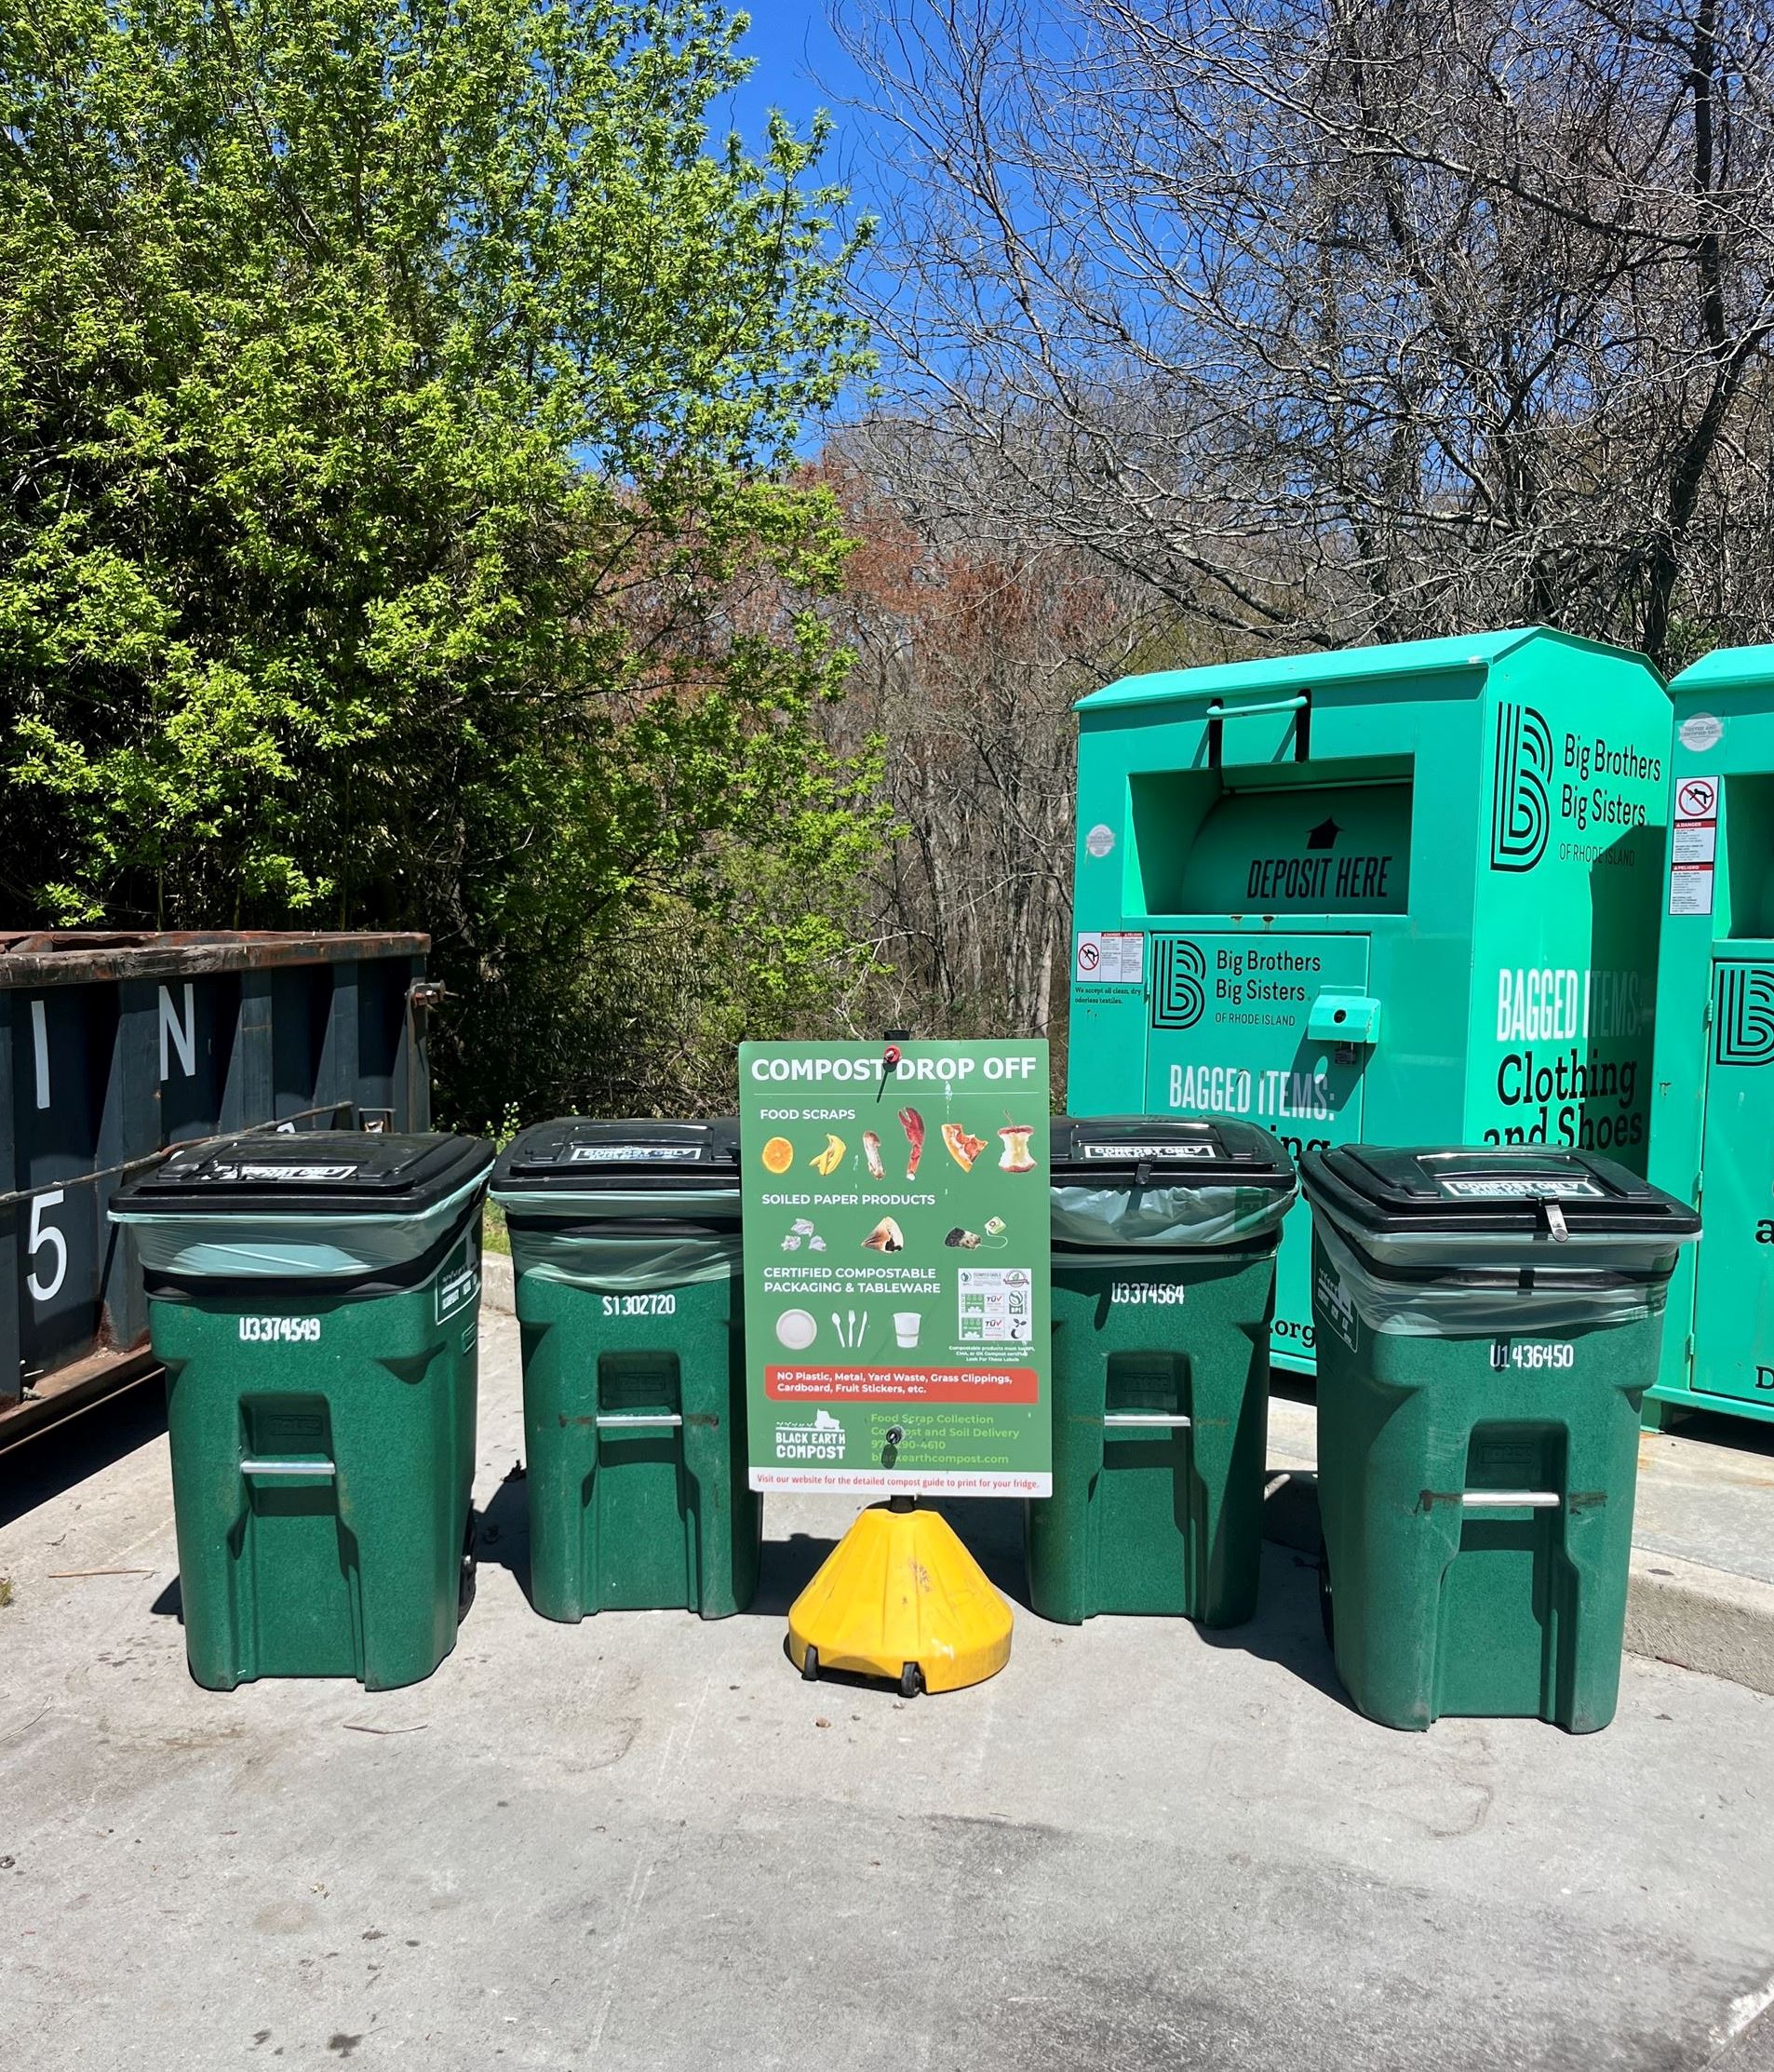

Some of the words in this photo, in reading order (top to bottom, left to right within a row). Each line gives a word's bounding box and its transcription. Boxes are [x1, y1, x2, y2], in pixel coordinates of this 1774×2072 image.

[1565, 733, 1591, 782] Big
[1594, 738, 1661, 782] Brothers
[1561, 783, 1588, 832] Big
[1559, 843, 1570, 861] OF
[1574, 844, 1603, 865] RHODE
[1606, 845, 1635, 868] ISLAND
[1246, 855, 1333, 899] DEPOSIT
[1335, 855, 1392, 899] HERE
[1216, 949, 1243, 974] Big
[1247, 949, 1321, 973] Brothers
[1112, 987, 1129, 995] clean,
[1131, 987, 1141, 995] dry
[1216, 980, 1242, 1005] Big
[1497, 968, 1578, 1043] BAGGED
[1583, 970, 1643, 1039] ITEMS:
[1215, 1012, 1226, 1025] OF
[1229, 1013, 1258, 1026] RHODE
[1261, 1014, 1296, 1027] ISLAND
[750, 1058, 885, 1081] COMPOST
[896, 1057, 974, 1081] DROP
[983, 1056, 1037, 1079] OFF
[1498, 1048, 1637, 1110] Clothing
[1169, 1064, 1252, 1114] BAGGED
[1258, 1070, 1336, 1122] ITEMS:
[759, 1109, 799, 1120] FOOD
[802, 1109, 856, 1120] SCRAPS
[1557, 1102, 1643, 1151] Shoes
[761, 1194, 811, 1204] SOILED
[813, 1194, 858, 1204] PAPER
[862, 1194, 935, 1205] PRODUCTS
[763, 1267, 833, 1279] CERTIFIED
[835, 1267, 936, 1279] COMPOSTABLE
[763, 1282, 842, 1294] PACKAGING
[845, 1282, 855, 1294] &
[857, 1282, 941, 1294] TABLEWARE
[1111, 1282, 1185, 1305] U3374564
[601, 1294, 677, 1316] S1302720
[238, 1317, 321, 1341] U3374549
[1489, 1343, 1575, 1369] U1436450
[776, 1371, 793, 1381] NO
[796, 1371, 833, 1382] Plastic,
[834, 1372, 867, 1383] Metal,
[868, 1372, 891, 1382] Yard
[894, 1373, 929, 1384] Waste,
[931, 1373, 959, 1383] Grass
[961, 1373, 1013, 1386] Clippings,
[776, 1383, 833, 1394] Cardboard,
[835, 1383, 860, 1393] Fruit
[862, 1383, 906, 1395] Stickers,
[907, 1385, 927, 1394] etc.
[870, 1413, 899, 1423] Food
[902, 1414, 934, 1425] Scrap
[936, 1415, 994, 1424] Collection
[775, 1432, 808, 1444] BLACK
[812, 1433, 846, 1445] EARTH
[870, 1426, 921, 1437] Coost
[924, 1427, 947, 1437] and
[949, 1427, 970, 1437] Soil
[973, 1428, 1020, 1440] Delivery
[776, 1445, 846, 1460] COMPOST
[757, 1473, 774, 1484] Visit
[791, 1474, 823, 1485] website
[825, 1474, 837, 1485] for
[838, 1475, 851, 1485] the
[853, 1475, 884, 1486] detailed
[887, 1477, 921, 1488] compost
[922, 1476, 944, 1489] guide
[947, 1478, 955, 1487] to
[957, 1477, 976, 1490] print
[979, 1477, 990, 1488] for
[992, 1479, 1011, 1490] your
[1013, 1478, 1040, 1491] fridge.
